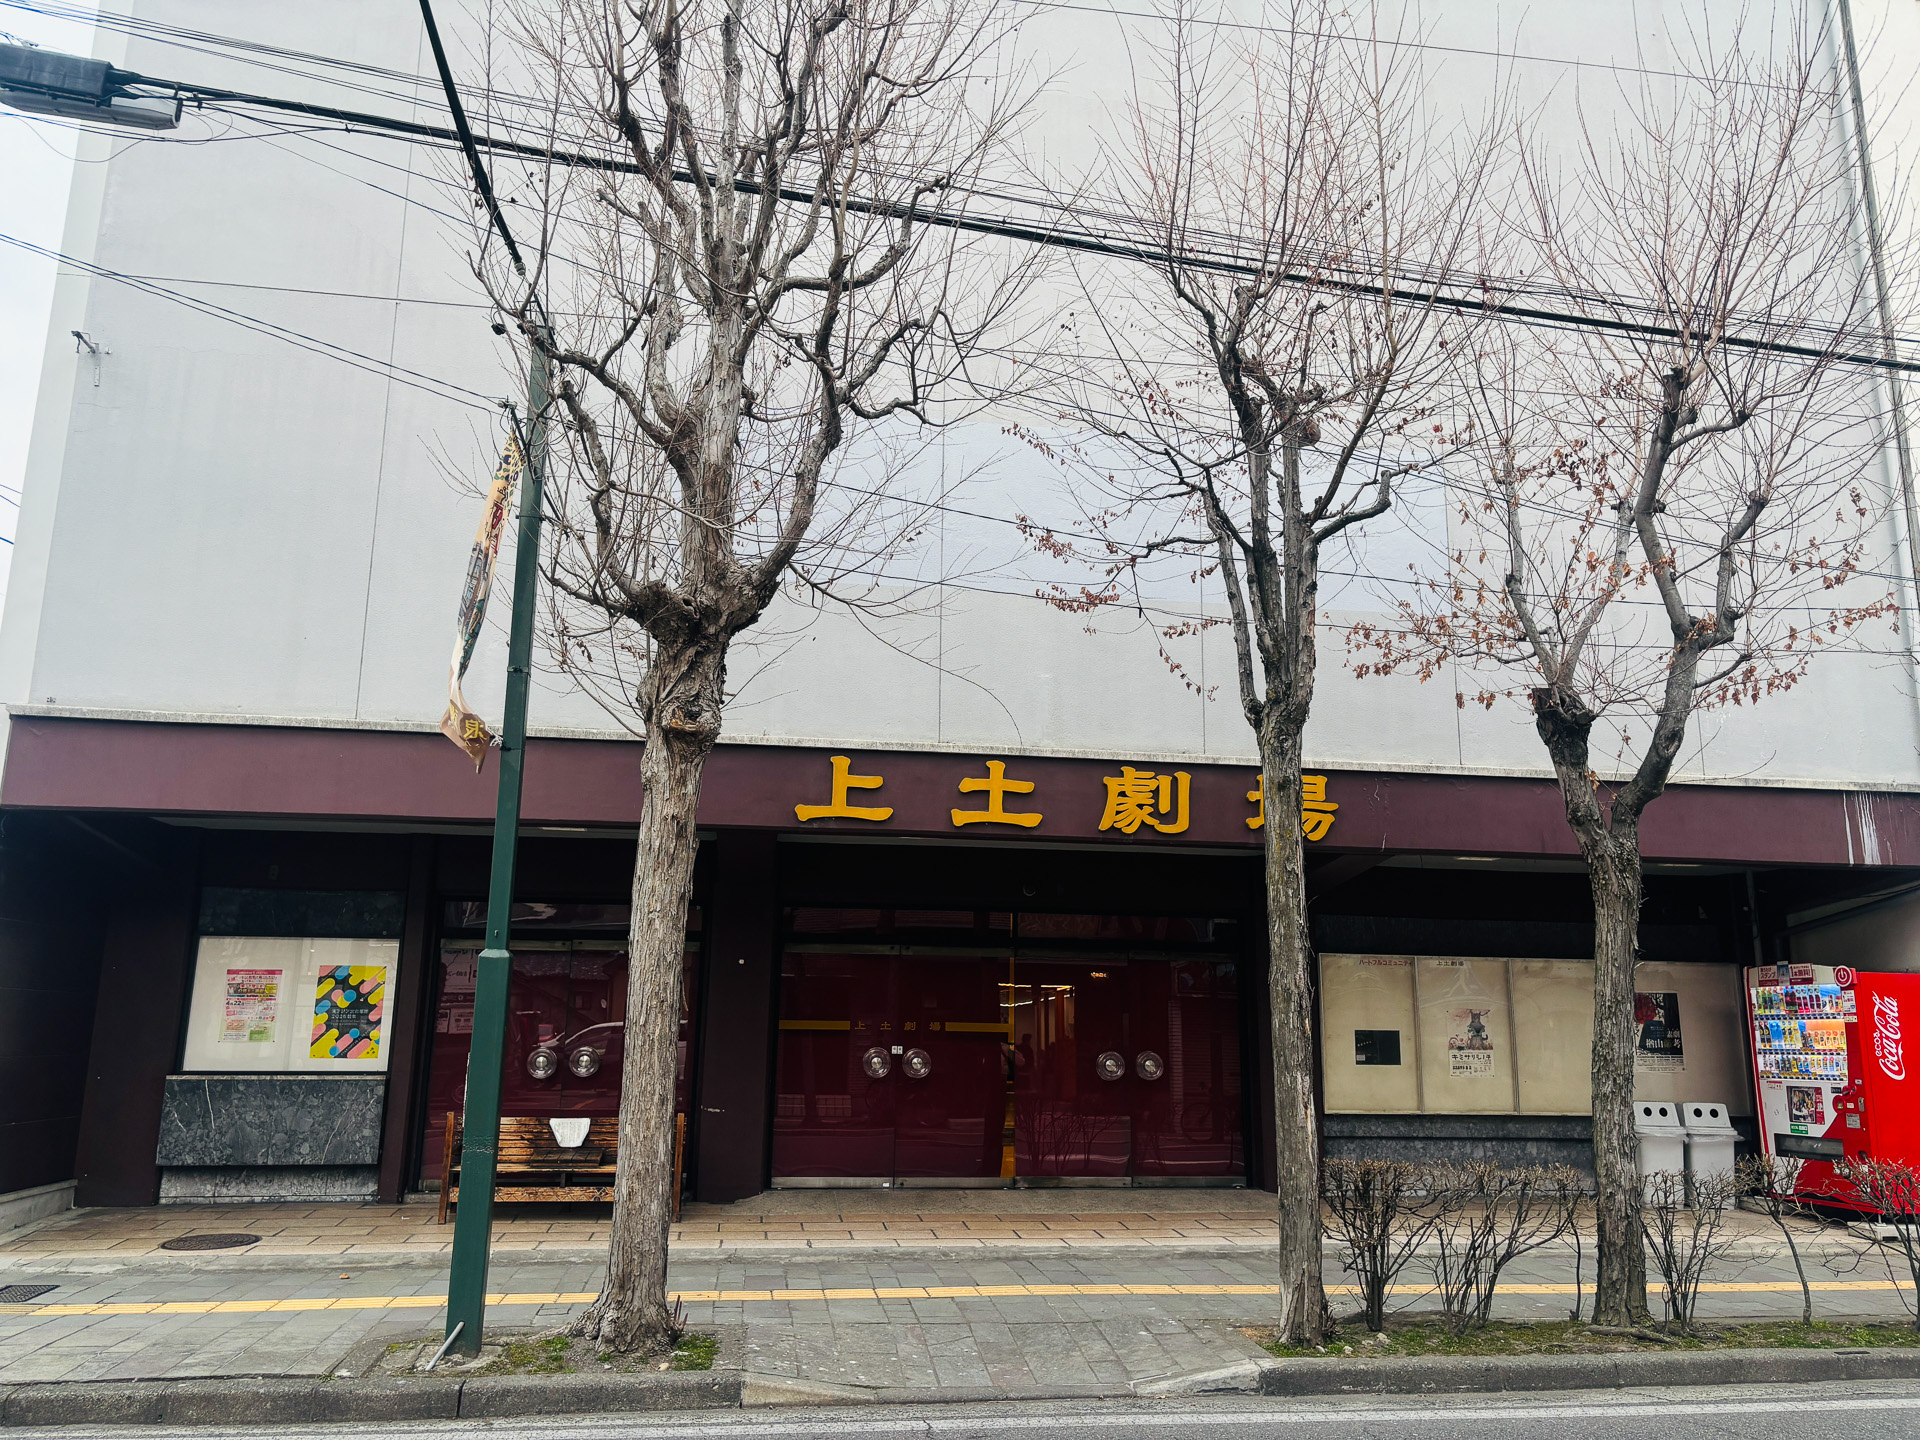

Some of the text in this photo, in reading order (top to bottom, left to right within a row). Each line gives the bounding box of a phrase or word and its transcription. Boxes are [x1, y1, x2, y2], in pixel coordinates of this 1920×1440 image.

[794, 755, 1339, 841] 上土劇場
[854, 1020, 941, 1031] 上土劇場
[1872, 990, 1906, 1081] Coca-Cola
